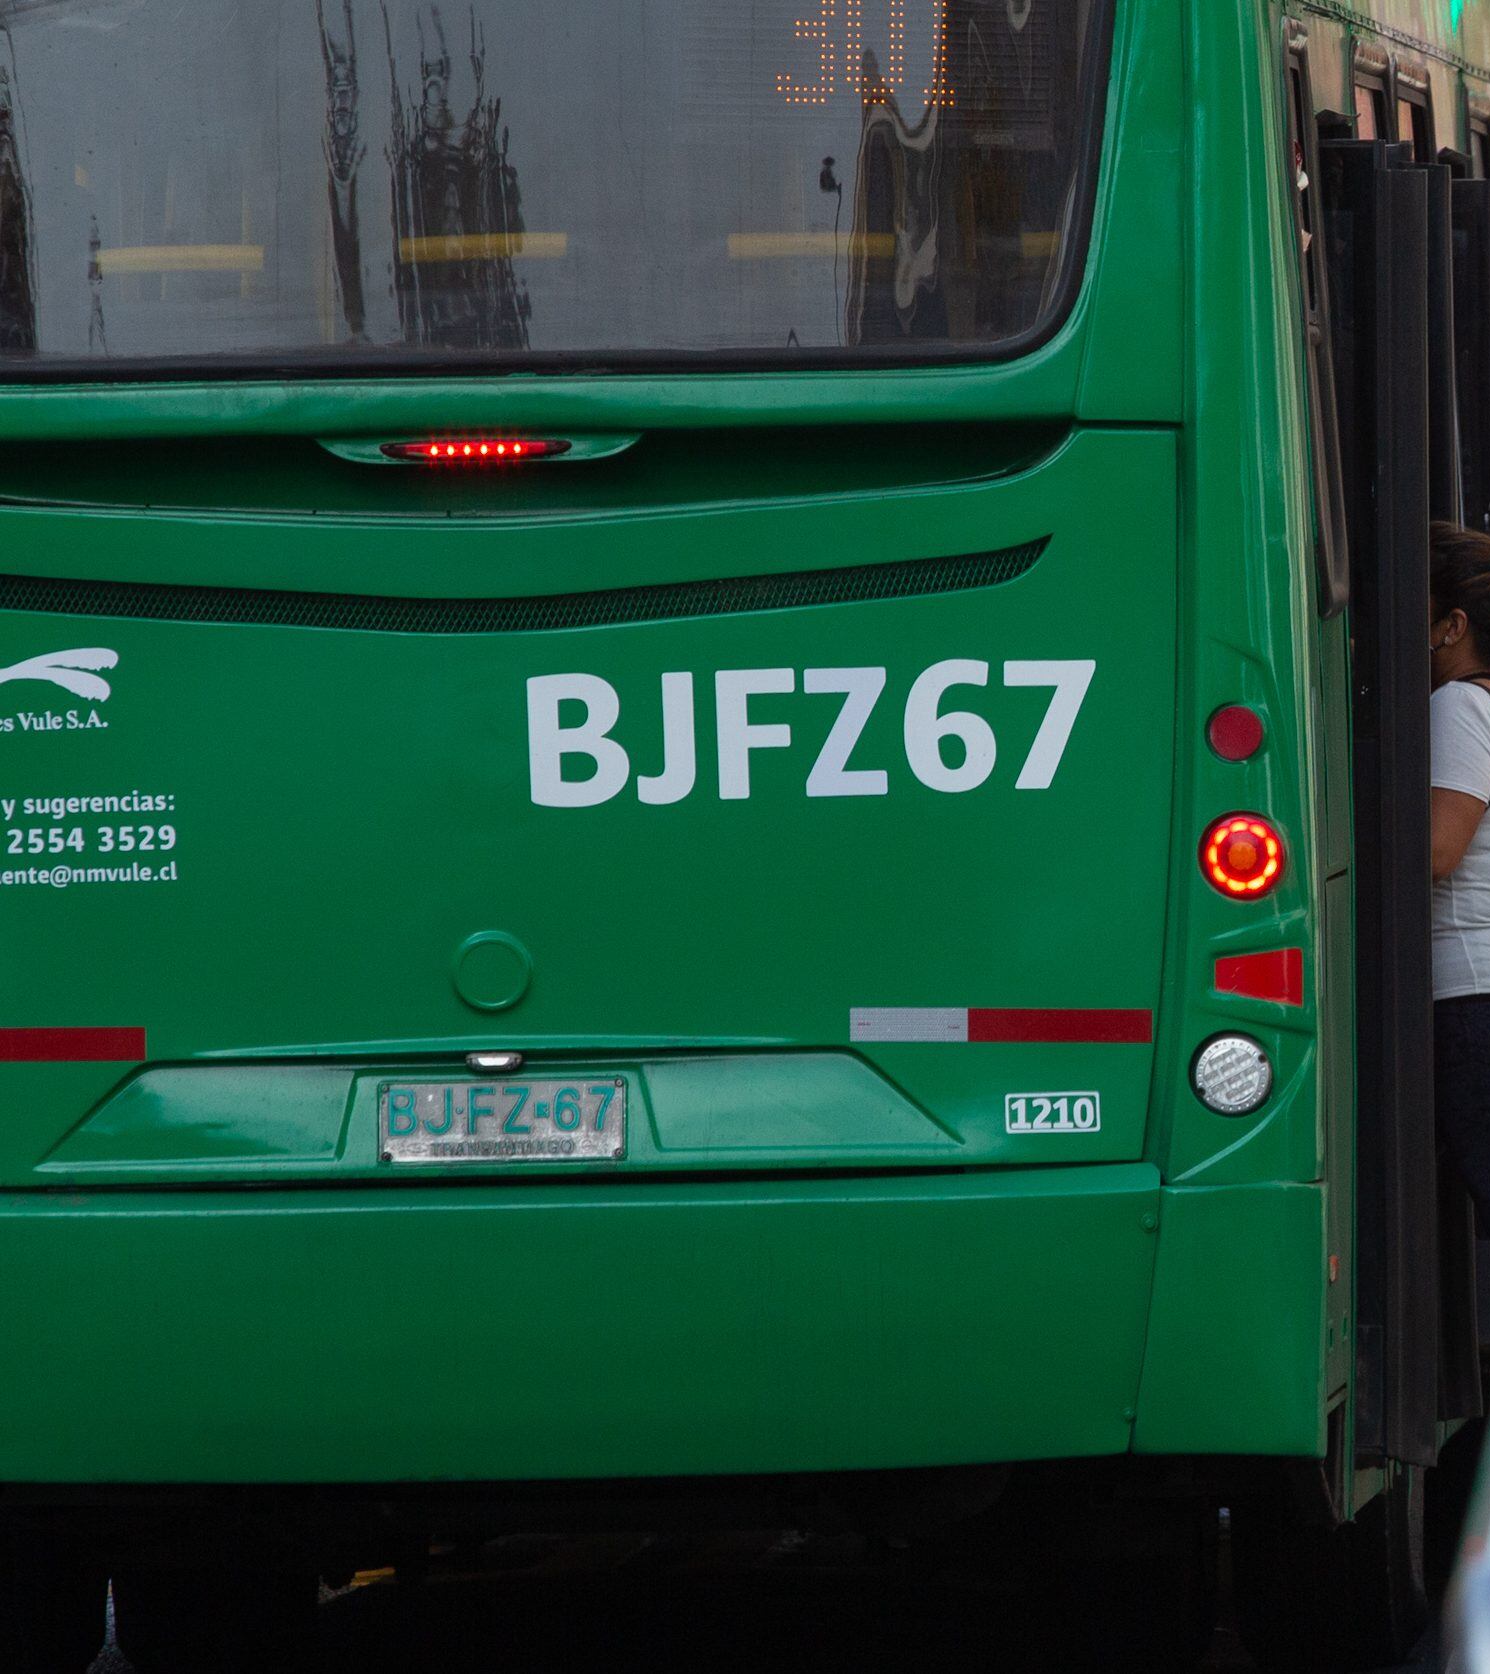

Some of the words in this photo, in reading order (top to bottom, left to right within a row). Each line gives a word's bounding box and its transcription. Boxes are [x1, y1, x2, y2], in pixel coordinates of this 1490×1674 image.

[16, 711, 63, 731] Vule
[66, 709, 108, 729] S.A.
[526, 659, 1097, 808] BJFZ67
[1, 799, 15, 821] y
[23, 790, 175, 819] sugerencias:
[7, 827, 85, 854] 2554
[97, 825, 176, 852] 3529
[0, 861, 177, 888] ente@nmvule.cl
[1010, 1097, 1095, 1130] 1210
